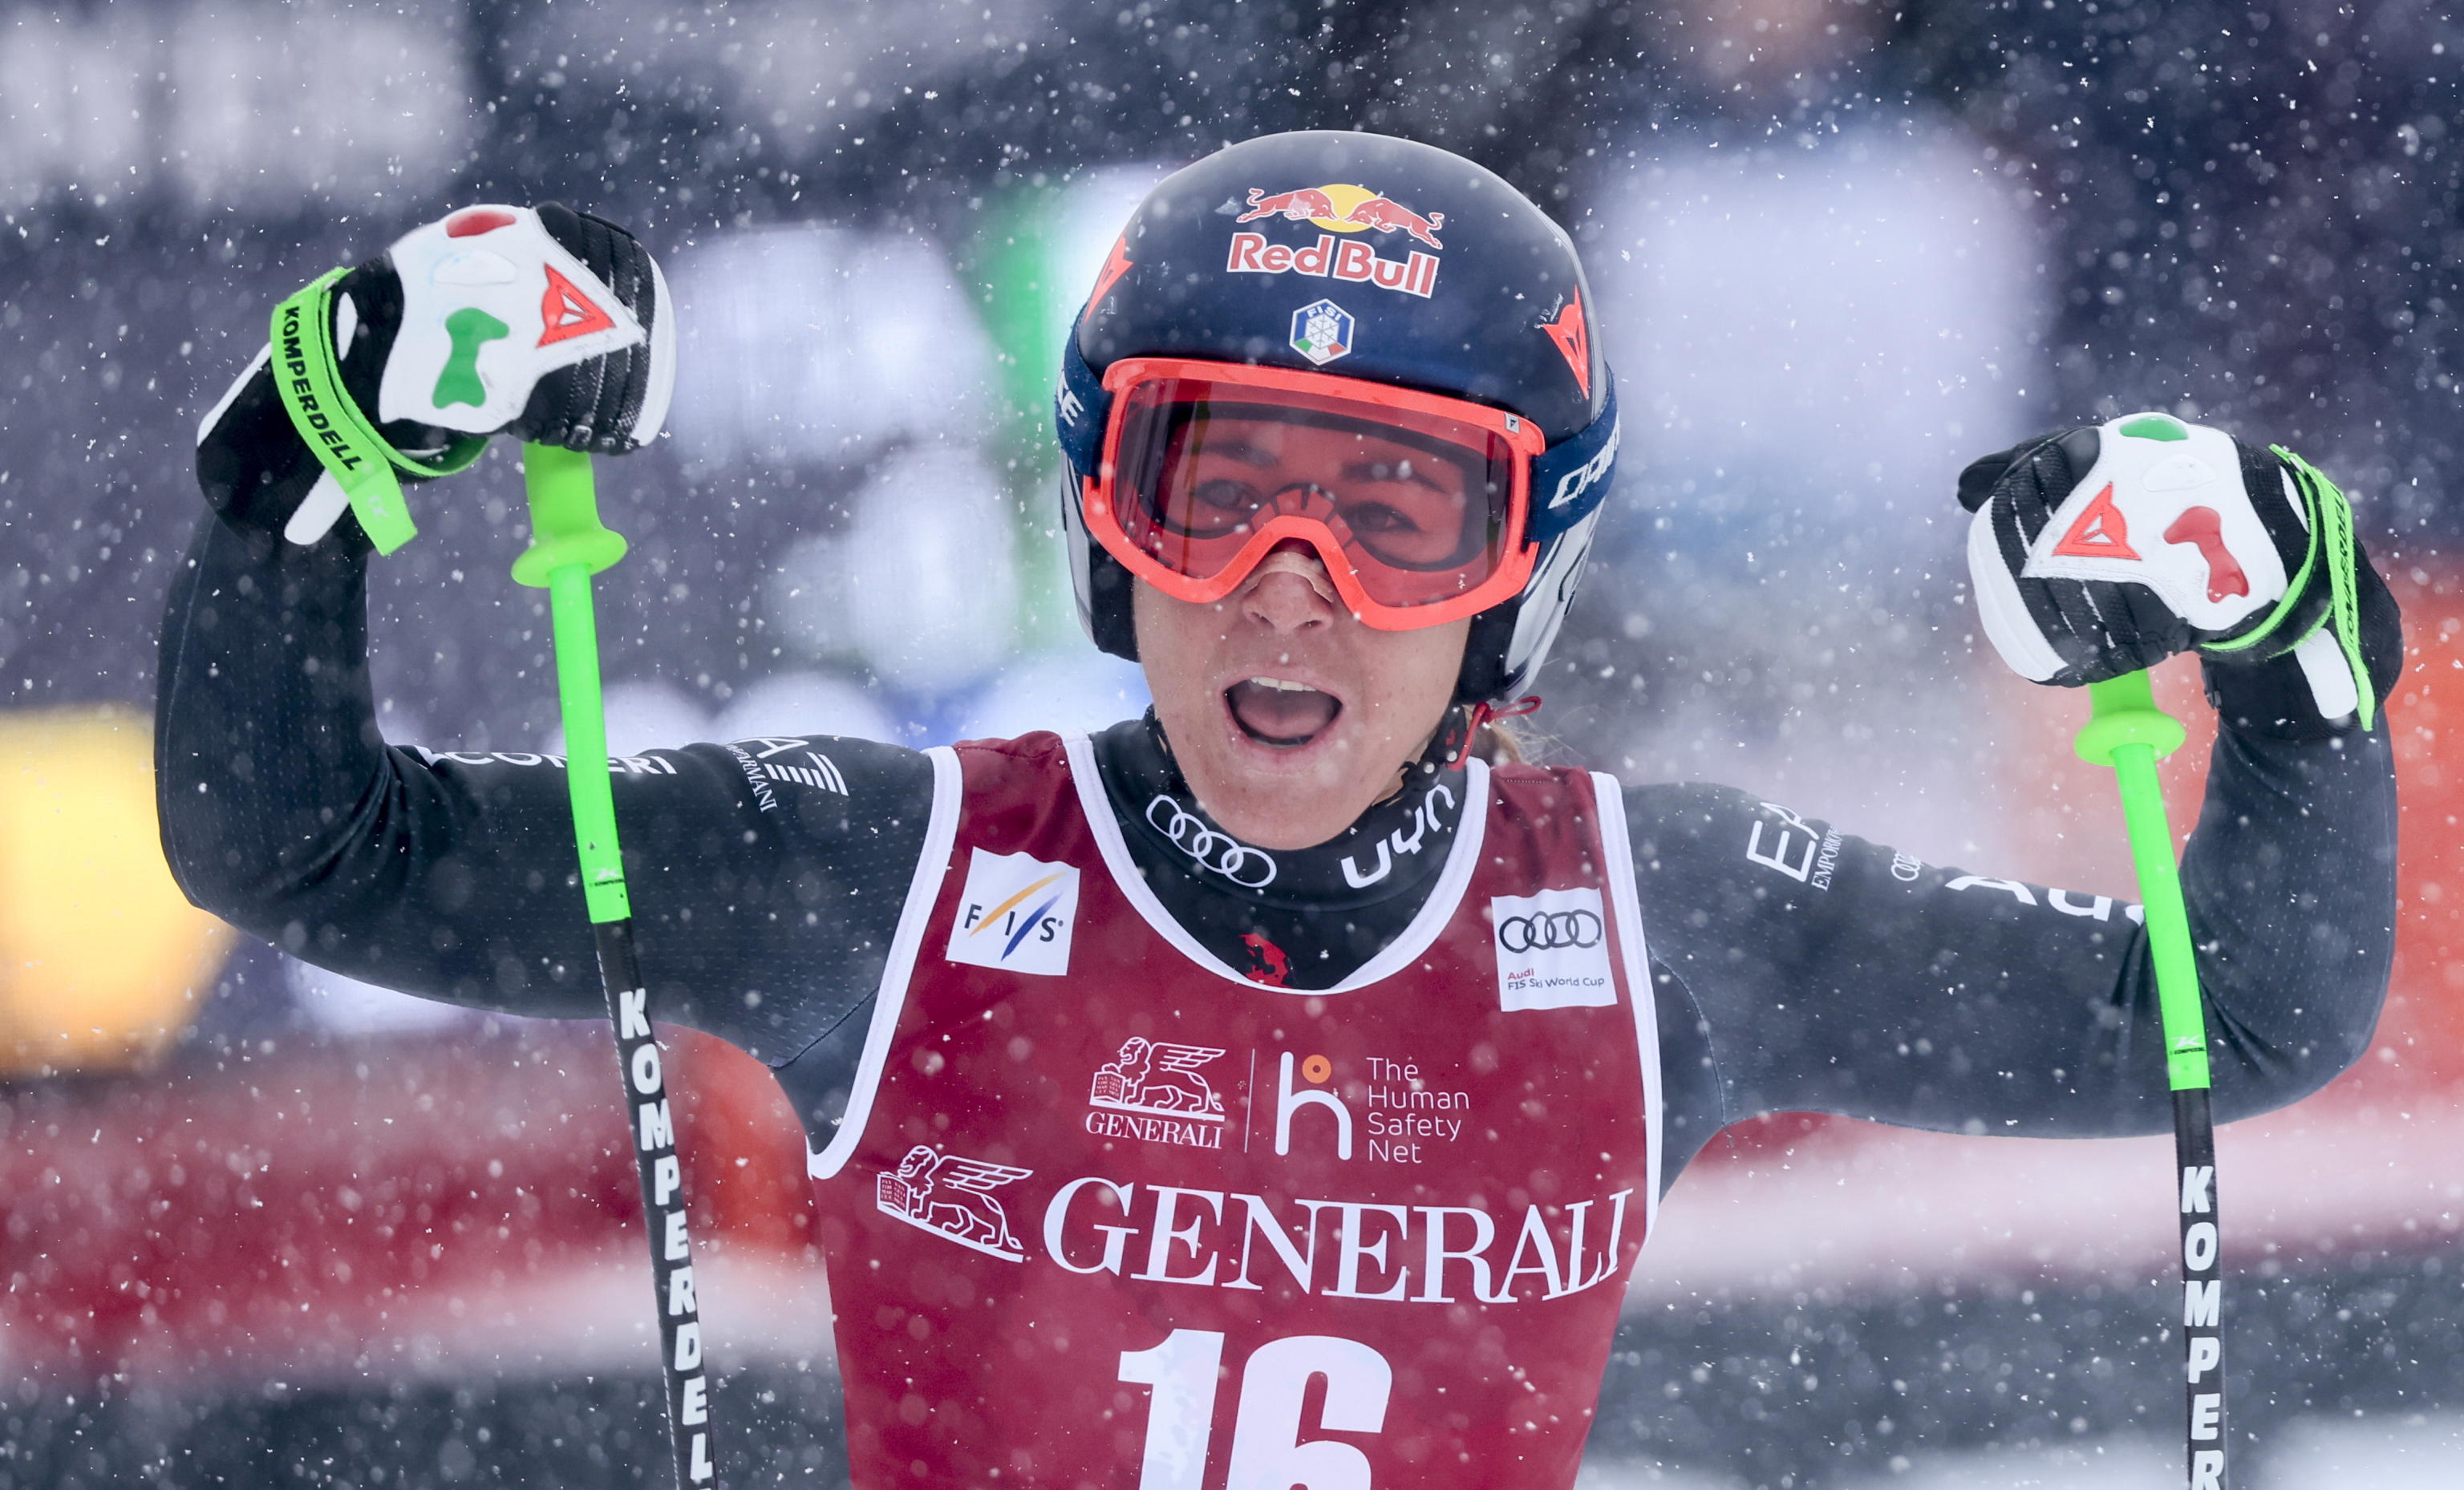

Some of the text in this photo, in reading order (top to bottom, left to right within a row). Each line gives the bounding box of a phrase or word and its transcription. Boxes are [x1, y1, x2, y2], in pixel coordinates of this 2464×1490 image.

[1227, 233, 1440, 299] Red Bull
[1307, 306, 1342, 321] FISI
[283, 306, 363, 471] KOMPERDELL
[964, 903, 1058, 942] FIS
[1508, 968, 1534, 980] Audi
[1508, 977, 1604, 990] FIS Ski World Cup
[1366, 1057, 1419, 1082] The
[1368, 1085, 1470, 1110] Human
[1085, 1111, 1225, 1149] GENERALI
[1368, 1111, 1462, 1142] Safety
[1368, 1139, 1422, 1164] Net
[619, 988, 714, 1490] KOMPERDEL
[1043, 1176, 1634, 1304] GENERALI
[2181, 1165, 2225, 1490] KOMPER
[1117, 1328, 1393, 1490] 16
